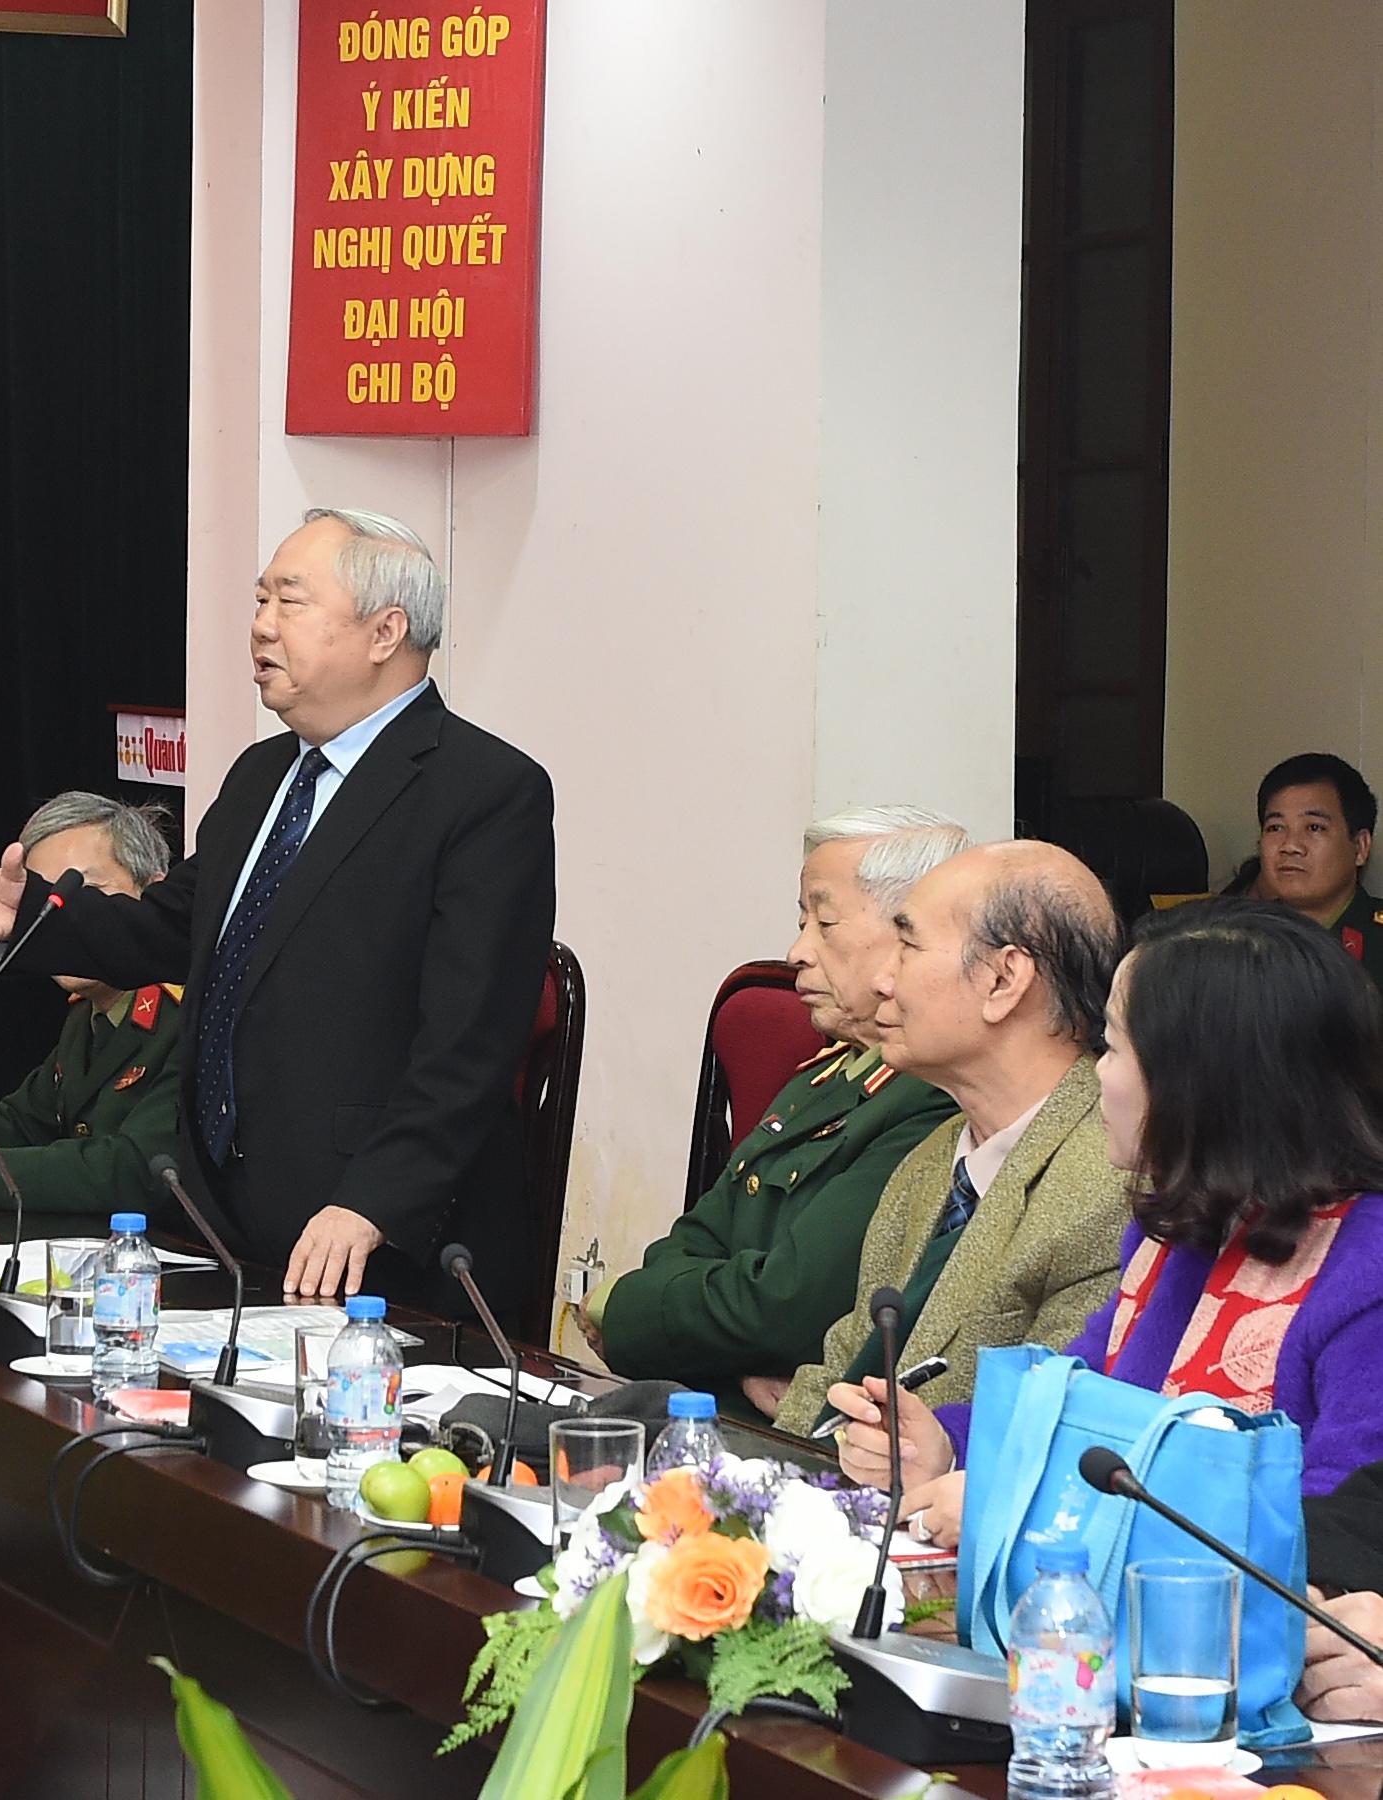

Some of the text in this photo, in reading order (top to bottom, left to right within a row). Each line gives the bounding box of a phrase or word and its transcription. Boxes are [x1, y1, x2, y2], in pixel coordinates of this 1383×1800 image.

[338, 5, 511, 63] ĐÓNG GÓP
[361, 75, 471, 132] Ý KIẾN
[328, 149, 495, 206] XÂY DỰNG
[313, 212, 507, 274] NGHỊ QUYẾT
[343, 288, 465, 347] ĐẠI HỘI
[347, 353, 457, 411] CHI BỘ
